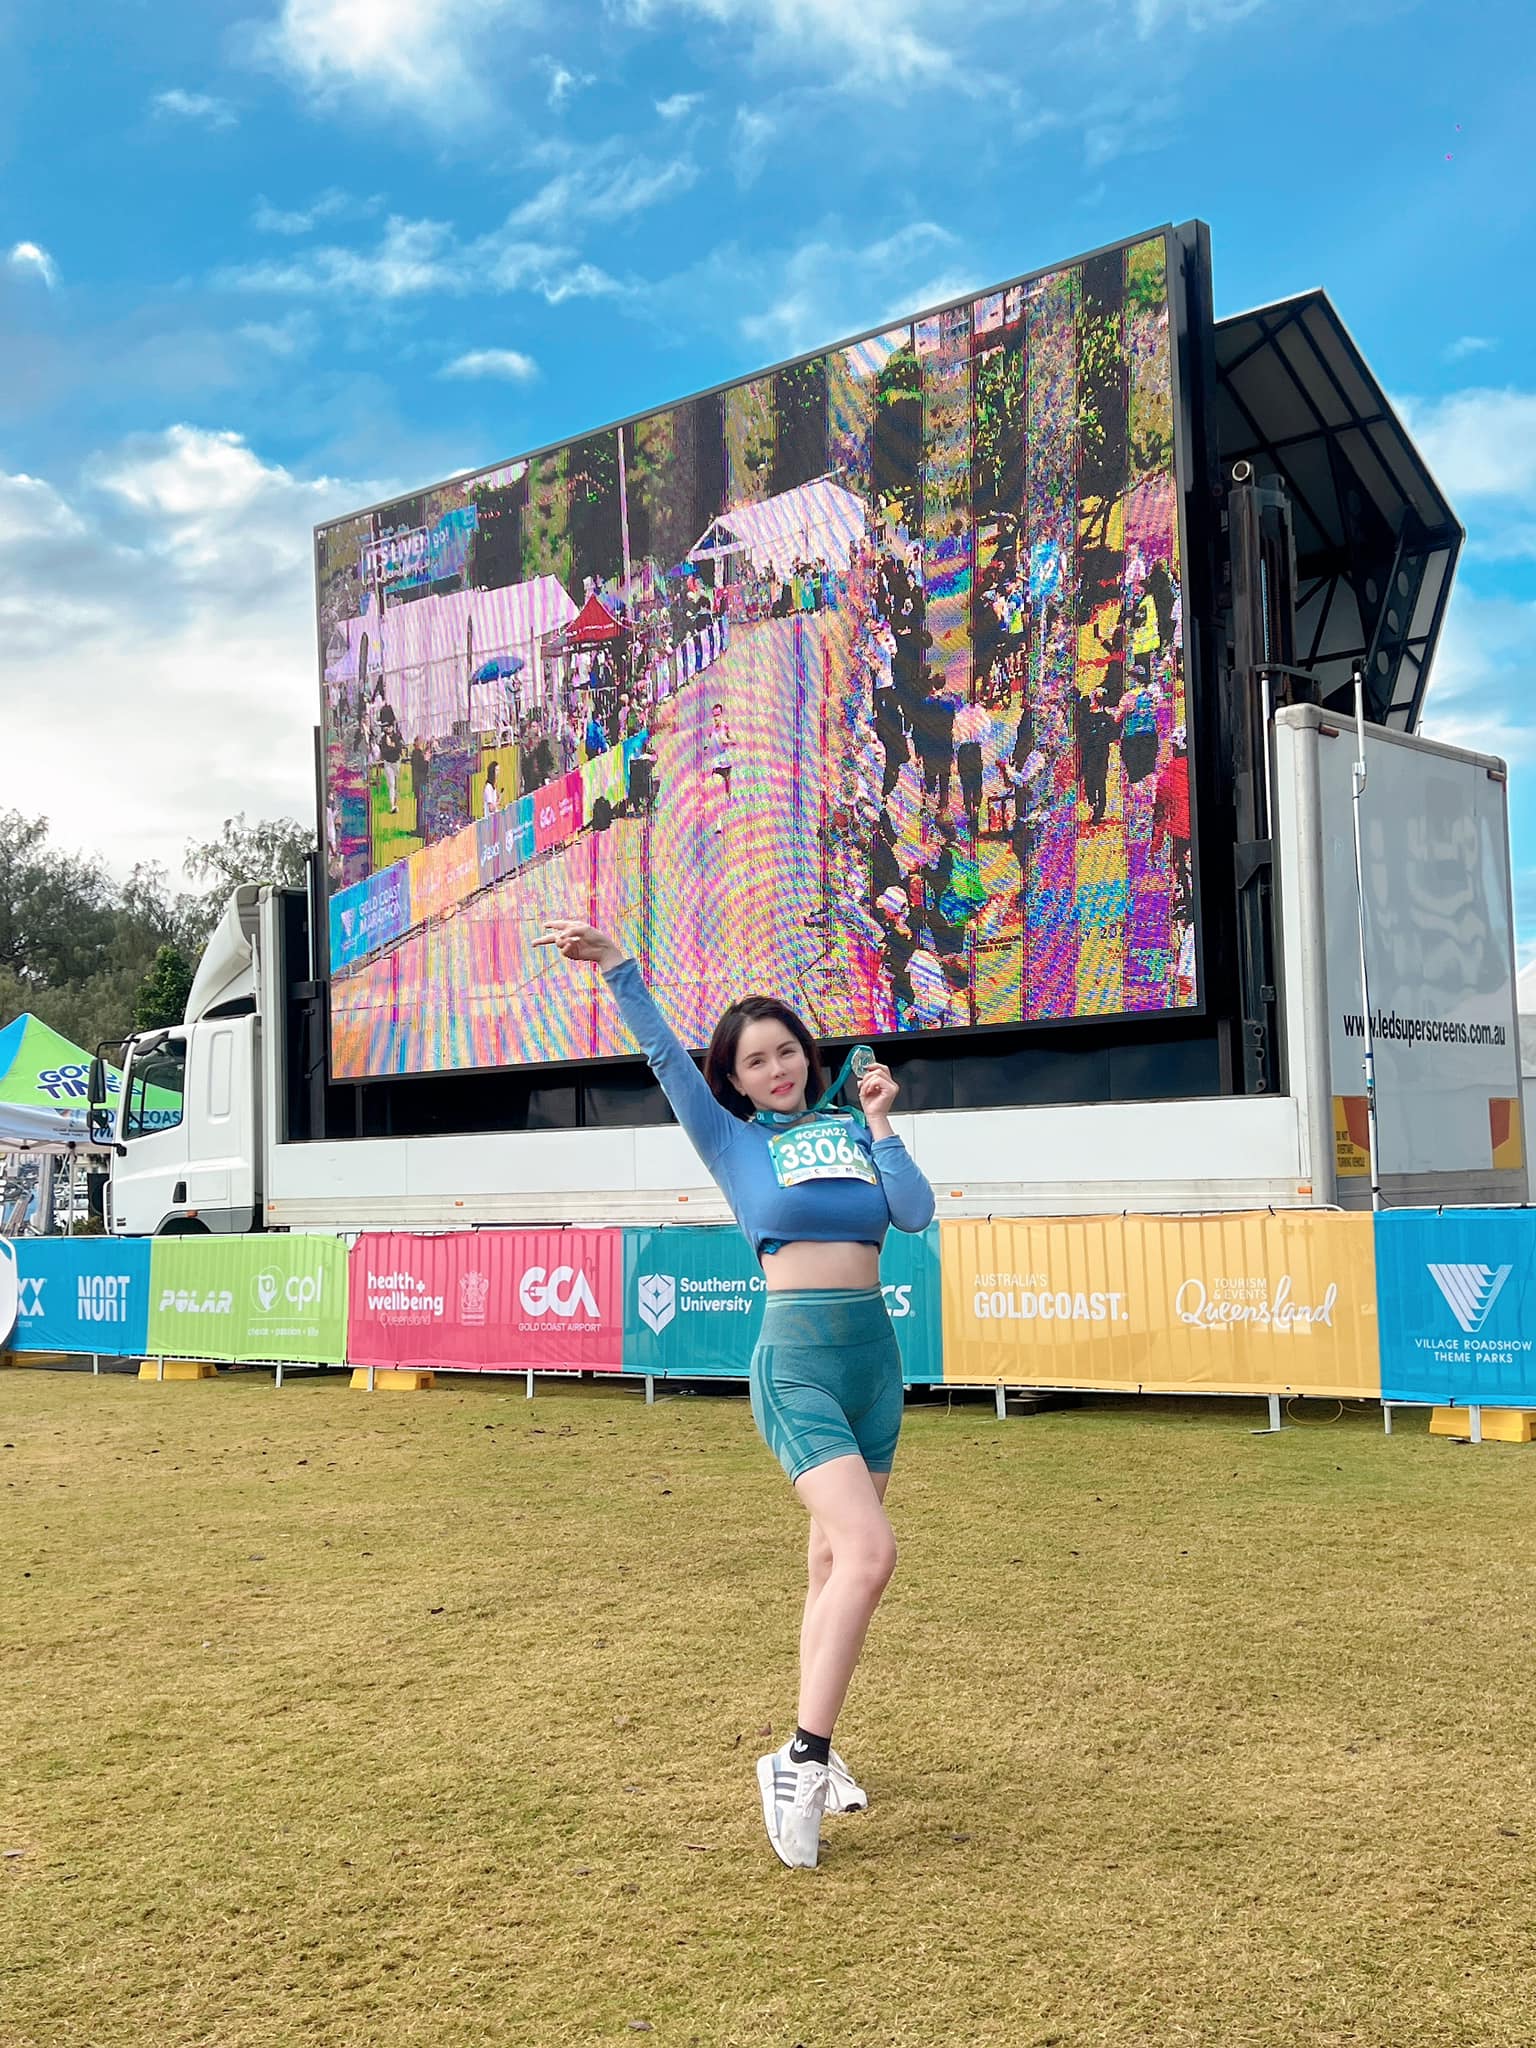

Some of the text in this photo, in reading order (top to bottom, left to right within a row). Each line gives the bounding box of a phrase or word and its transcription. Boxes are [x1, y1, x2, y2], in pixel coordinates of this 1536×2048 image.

[795, 1127, 848, 1141] #GCM22
[285, 1265, 323, 1311] cpl
[680, 1276, 768, 1292] Southern Cr
[974, 1273, 1048, 1288] AUSTRALIA'S
[1213, 1278, 1267, 1289] TOURISM
[78, 1275, 130, 1322] NORT
[519, 1266, 601, 1317] GCA
[1213, 1289, 1267, 1300] & EVENTS
[159, 1289, 233, 1314] POLAR
[367, 1291, 444, 1316] wellbeing
[680, 1295, 753, 1315] University
[1175, 1274, 1338, 1329] Queensland
[379, 1313, 432, 1328] Queensland
[518, 1322, 602, 1332] GOLD COAST AIRPORT
[1415, 1338, 1533, 1351] VILLAGE ROADSHOW
[1433, 1351, 1513, 1364] THEME PARKS
